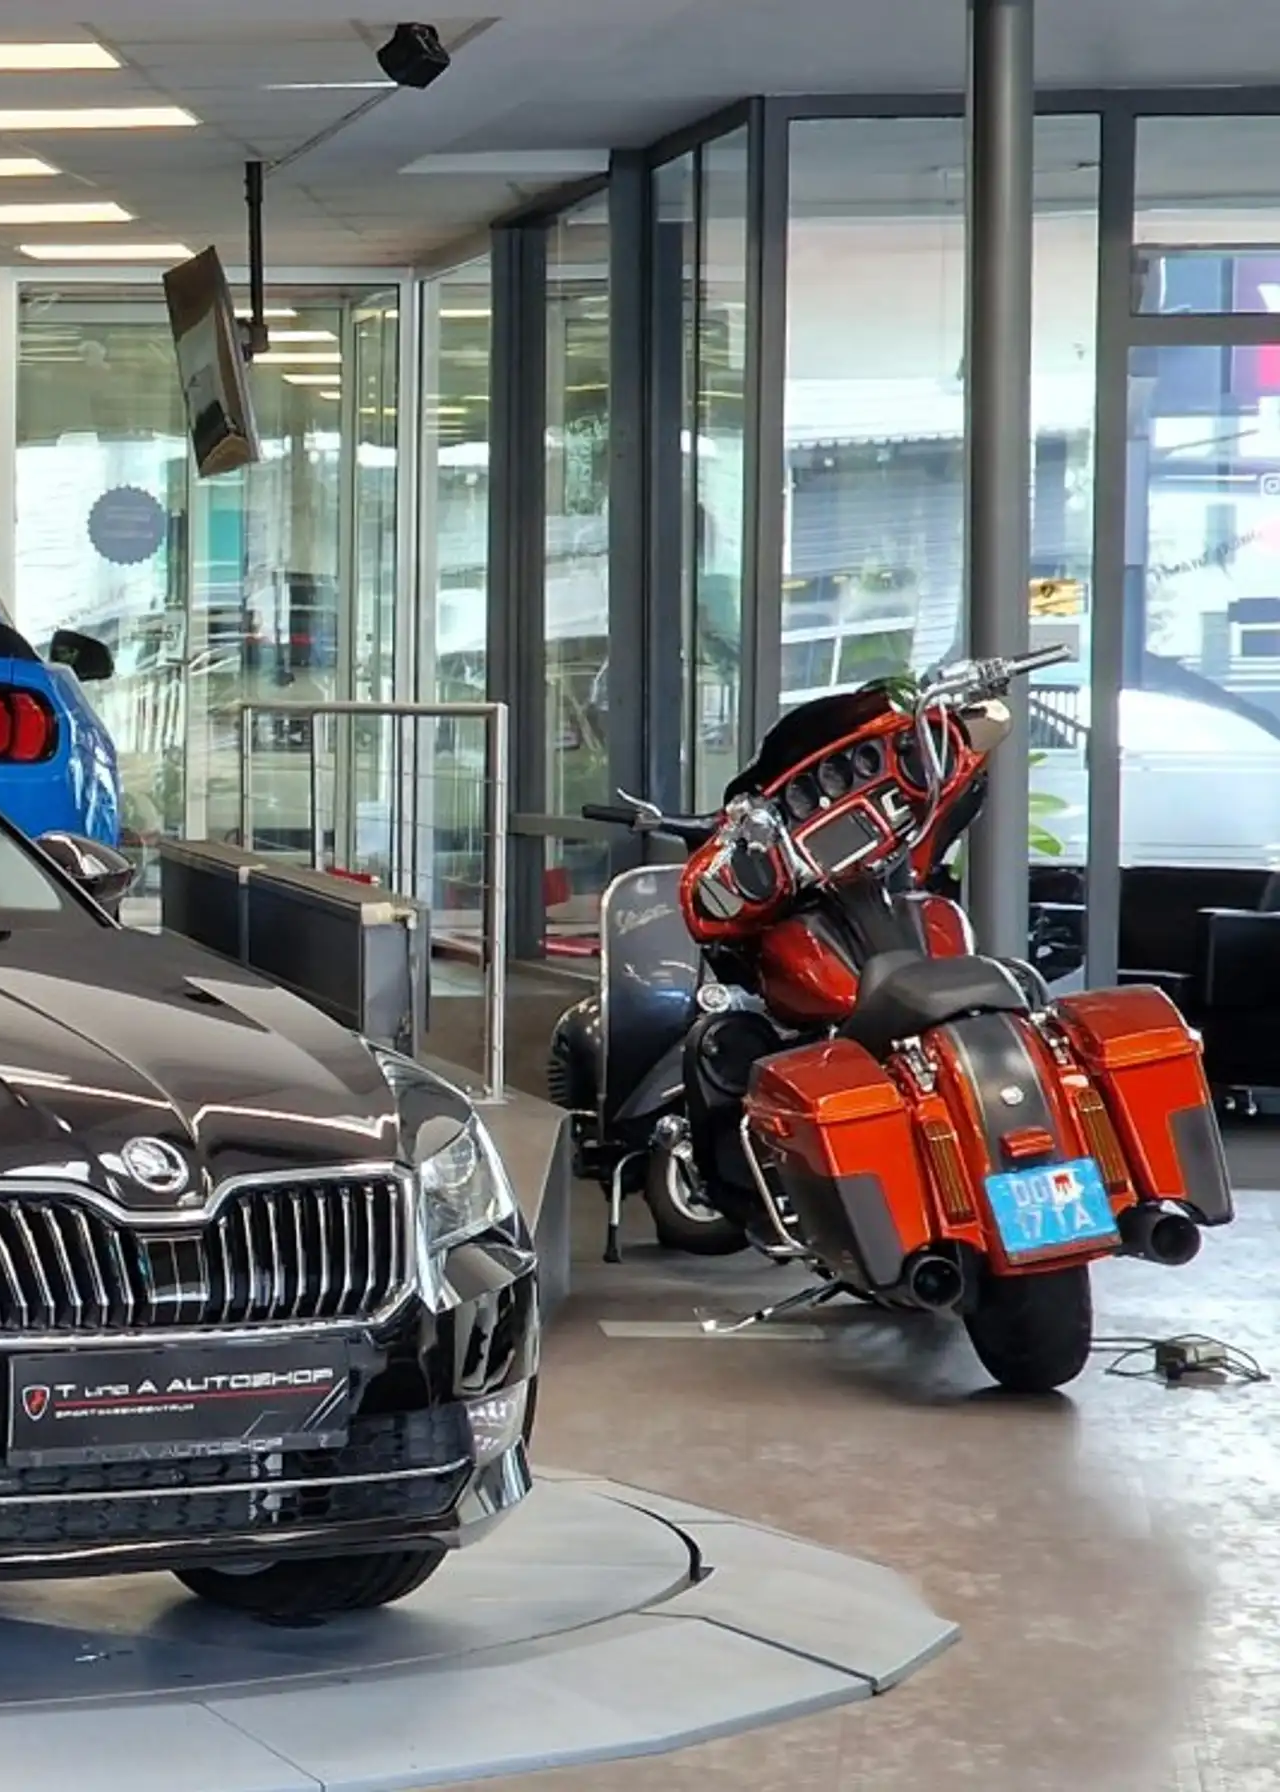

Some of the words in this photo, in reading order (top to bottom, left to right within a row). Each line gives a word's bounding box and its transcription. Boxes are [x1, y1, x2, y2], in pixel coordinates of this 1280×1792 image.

[53, 1383, 78, 1399] T
[136, 1379, 159, 1394] A
[165, 1367, 334, 1392] AUTOSHOP
